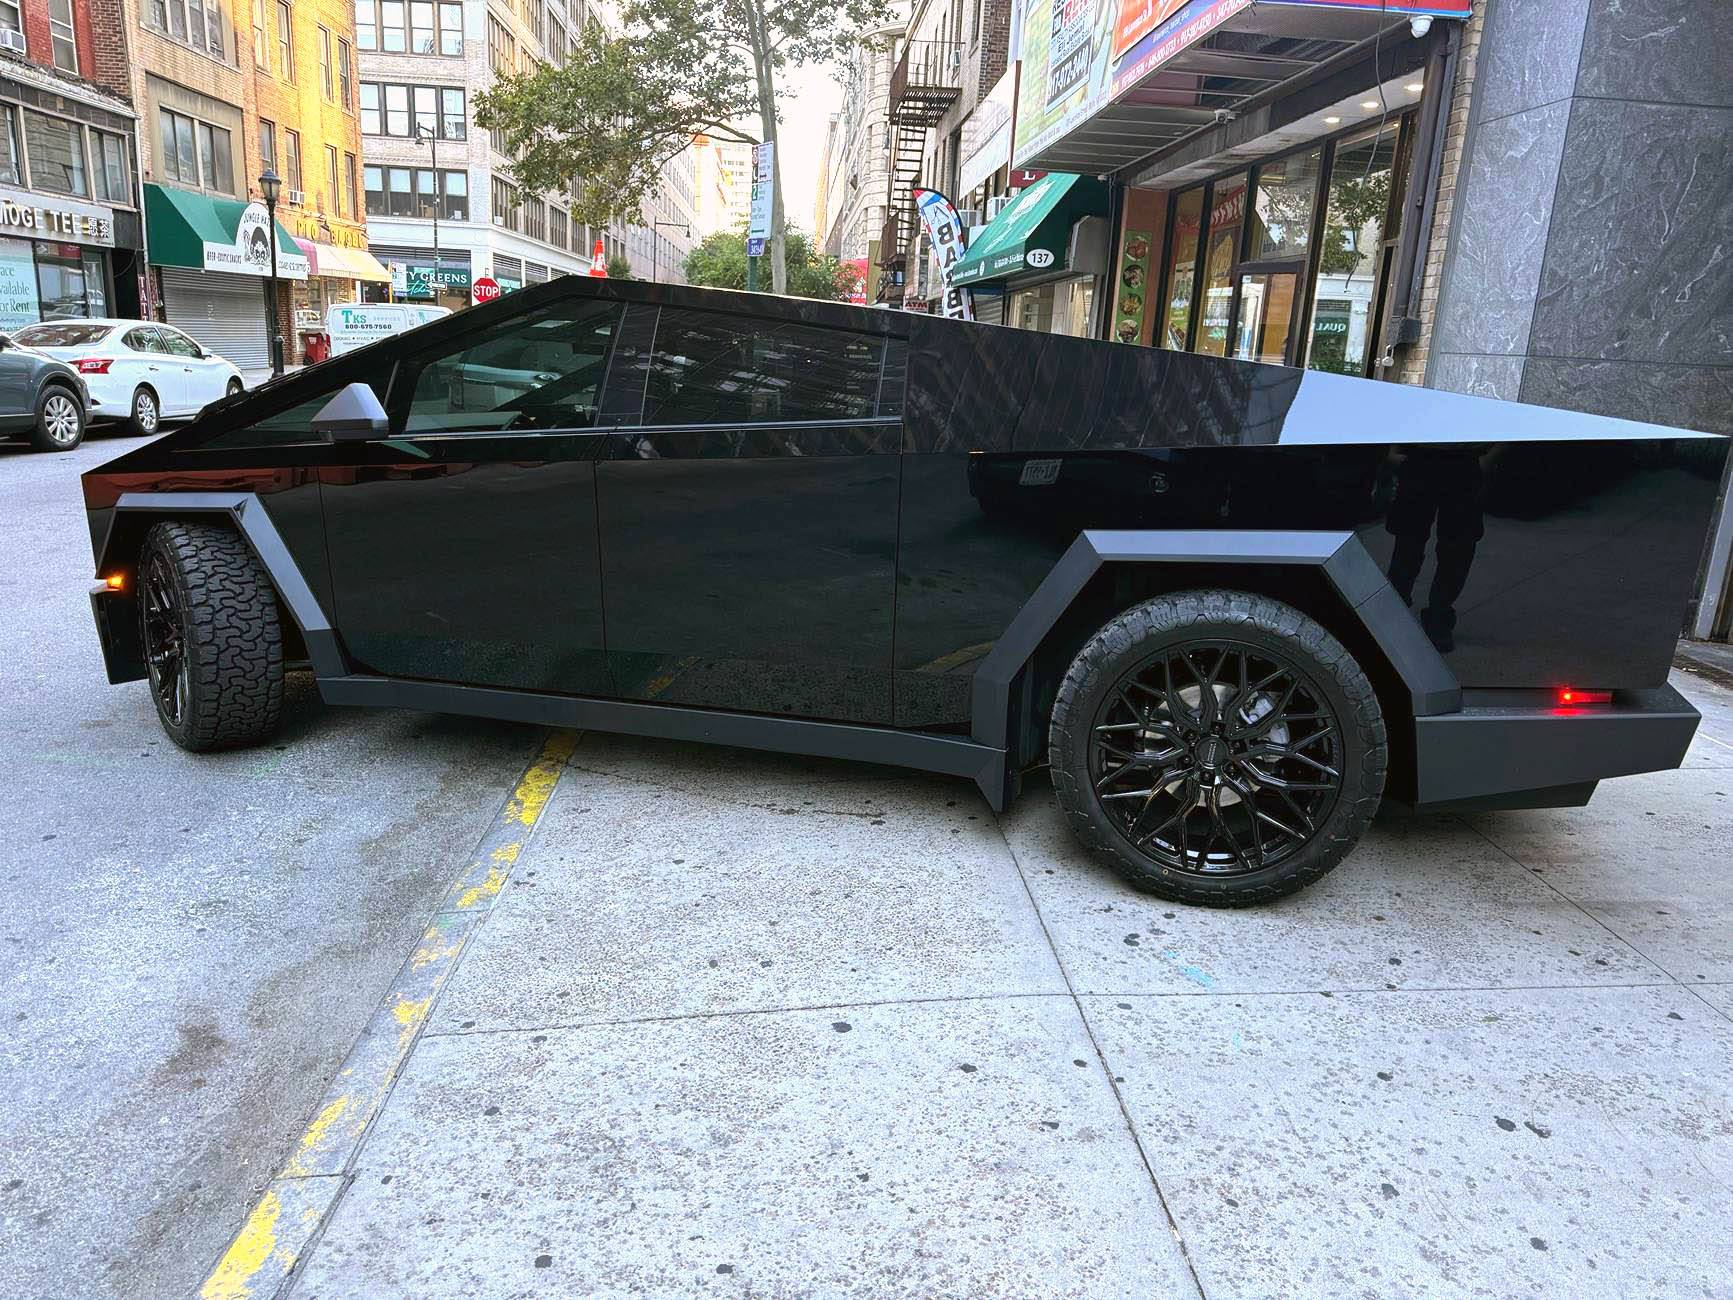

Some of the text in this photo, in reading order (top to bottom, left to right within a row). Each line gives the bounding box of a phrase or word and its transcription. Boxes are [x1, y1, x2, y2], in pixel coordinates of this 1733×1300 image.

[50, 210, 81, 234] TEE
[1032, 253, 1049, 264] 137
[420, 272, 467, 283] GREENS
[474, 285, 499, 298] STOP
[10, 298, 30, 313] Rent
[905, 301, 928, 309] ATM
[341, 310, 367, 324] TKS
